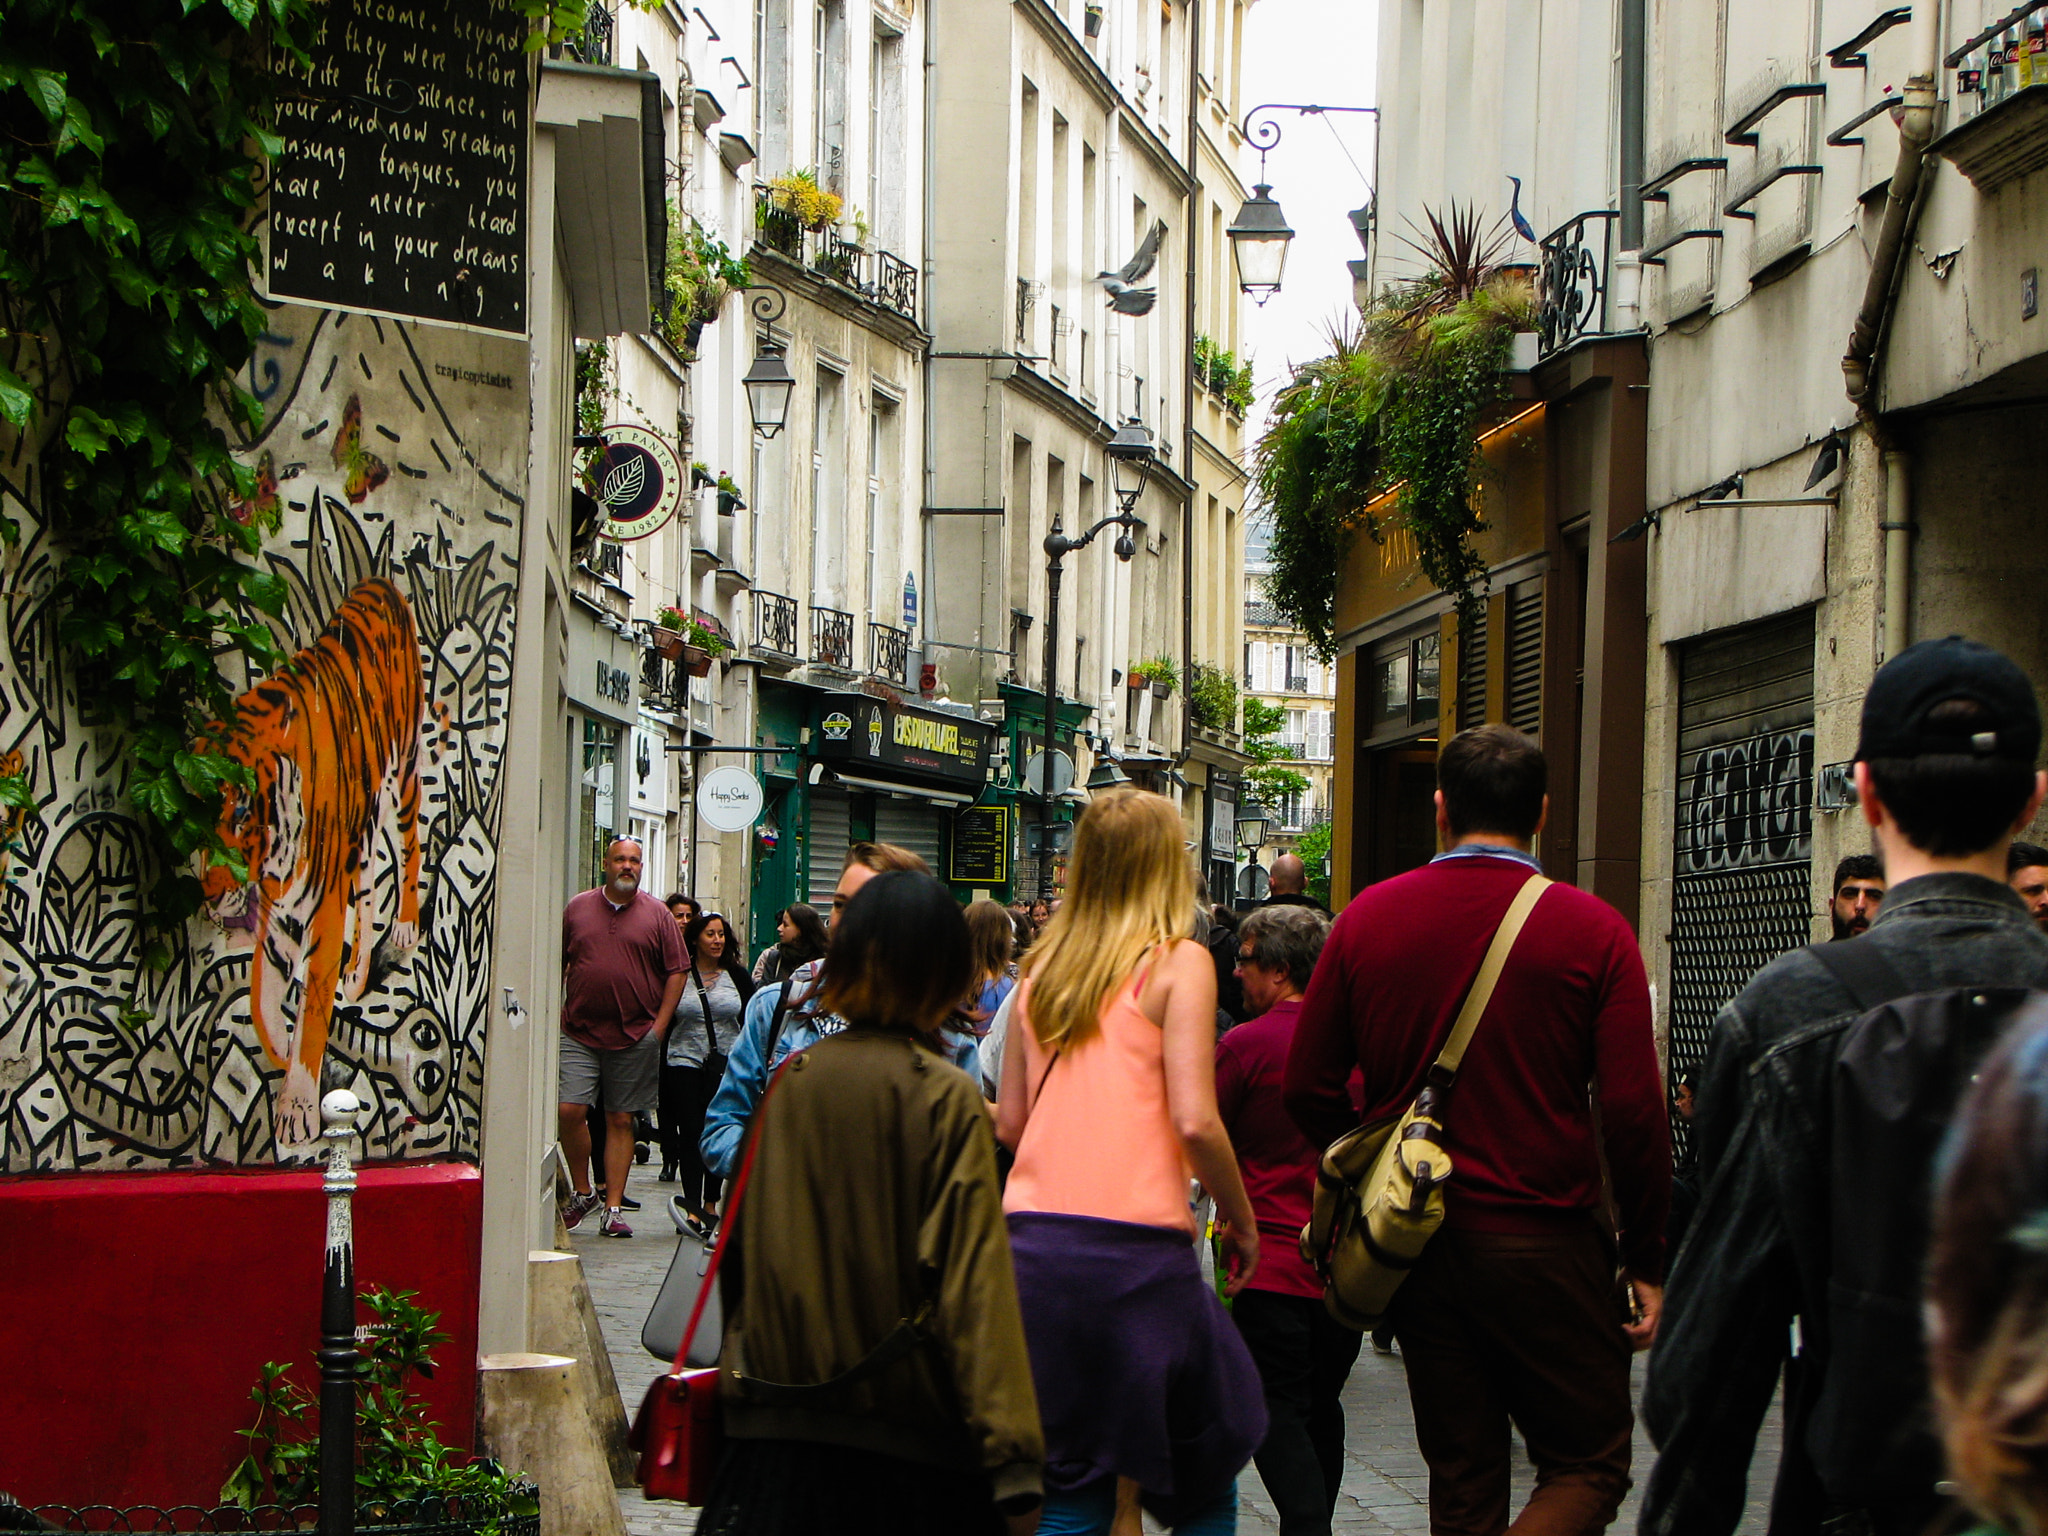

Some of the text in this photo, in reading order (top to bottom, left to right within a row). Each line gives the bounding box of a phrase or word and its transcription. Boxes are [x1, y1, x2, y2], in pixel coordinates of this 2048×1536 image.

[345, 21, 387, 70] they
[403, 43, 446, 72] were
[465, 52, 515, 87] before
[453, 12, 520, 55] beyond
[365, 64, 393, 98] the
[418, 83, 485, 119] silence.
[502, 101, 516, 128] in
[274, 101, 319, 126] your
[388, 120, 428, 143] now
[441, 128, 517, 176] speaking
[274, 167, 517, 236] have never heard
[380, 142, 460, 193] tongues.
[486, 177, 517, 206] you
[274, 210, 518, 274] except in your dreams
[632, 432, 671, 467] PANTS
[632, 515, 659, 535] 1982
[710, 786, 750, 803] Happy Socks
